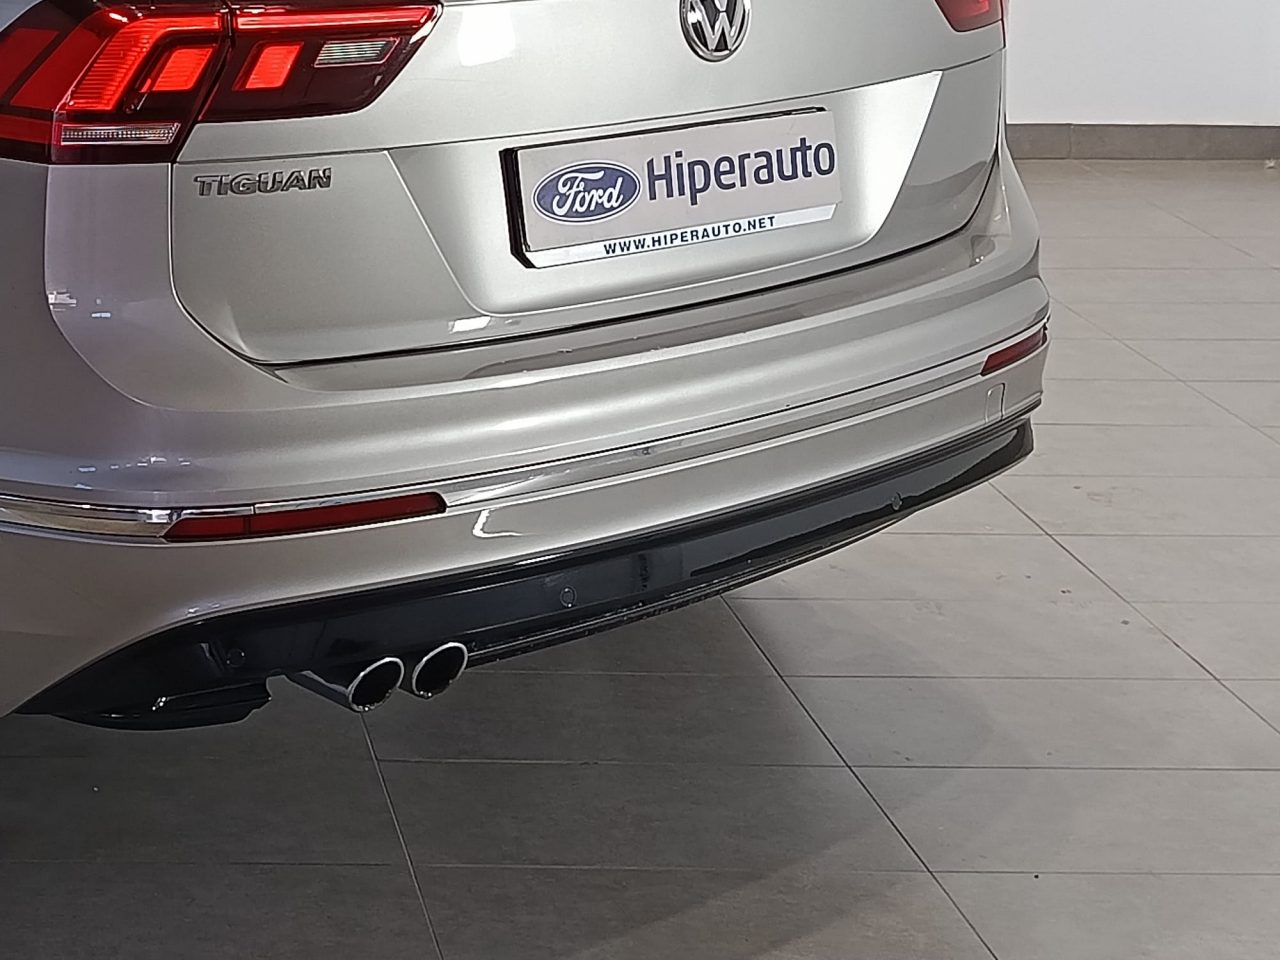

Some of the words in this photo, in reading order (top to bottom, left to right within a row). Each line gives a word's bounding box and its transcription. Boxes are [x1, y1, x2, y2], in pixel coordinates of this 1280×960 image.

[194, 167, 332, 196] TIGUAN
[552, 169, 624, 216] Ford
[646, 137, 836, 206] Hiperauto
[604, 215, 776, 255] WWW.HIPERAUTO.NET
